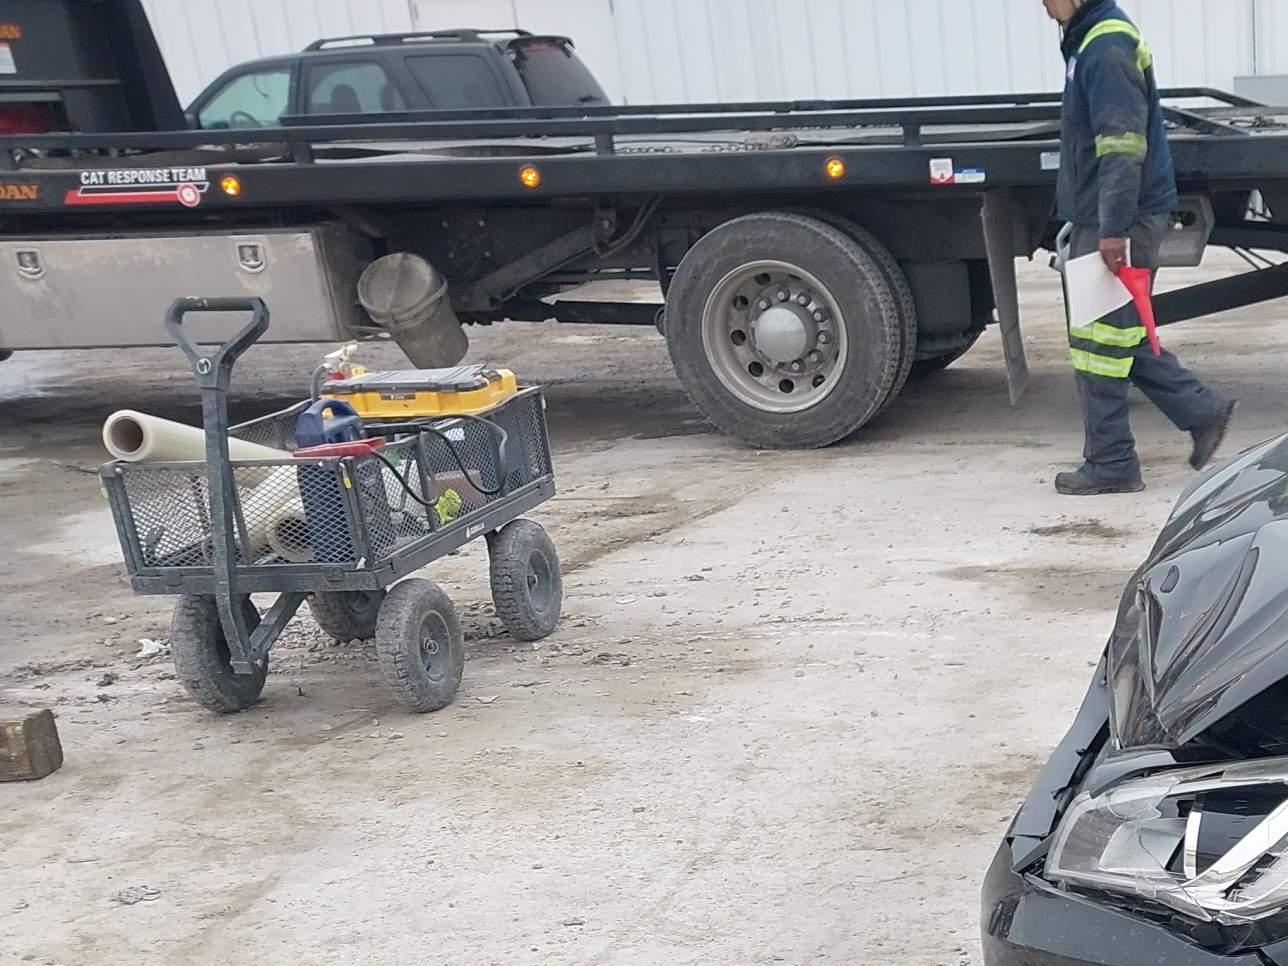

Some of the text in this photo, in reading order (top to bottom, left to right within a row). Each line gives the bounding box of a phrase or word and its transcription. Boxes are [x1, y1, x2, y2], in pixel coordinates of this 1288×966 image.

[80, 168, 207, 184] CAT RESPONSE TEAM
